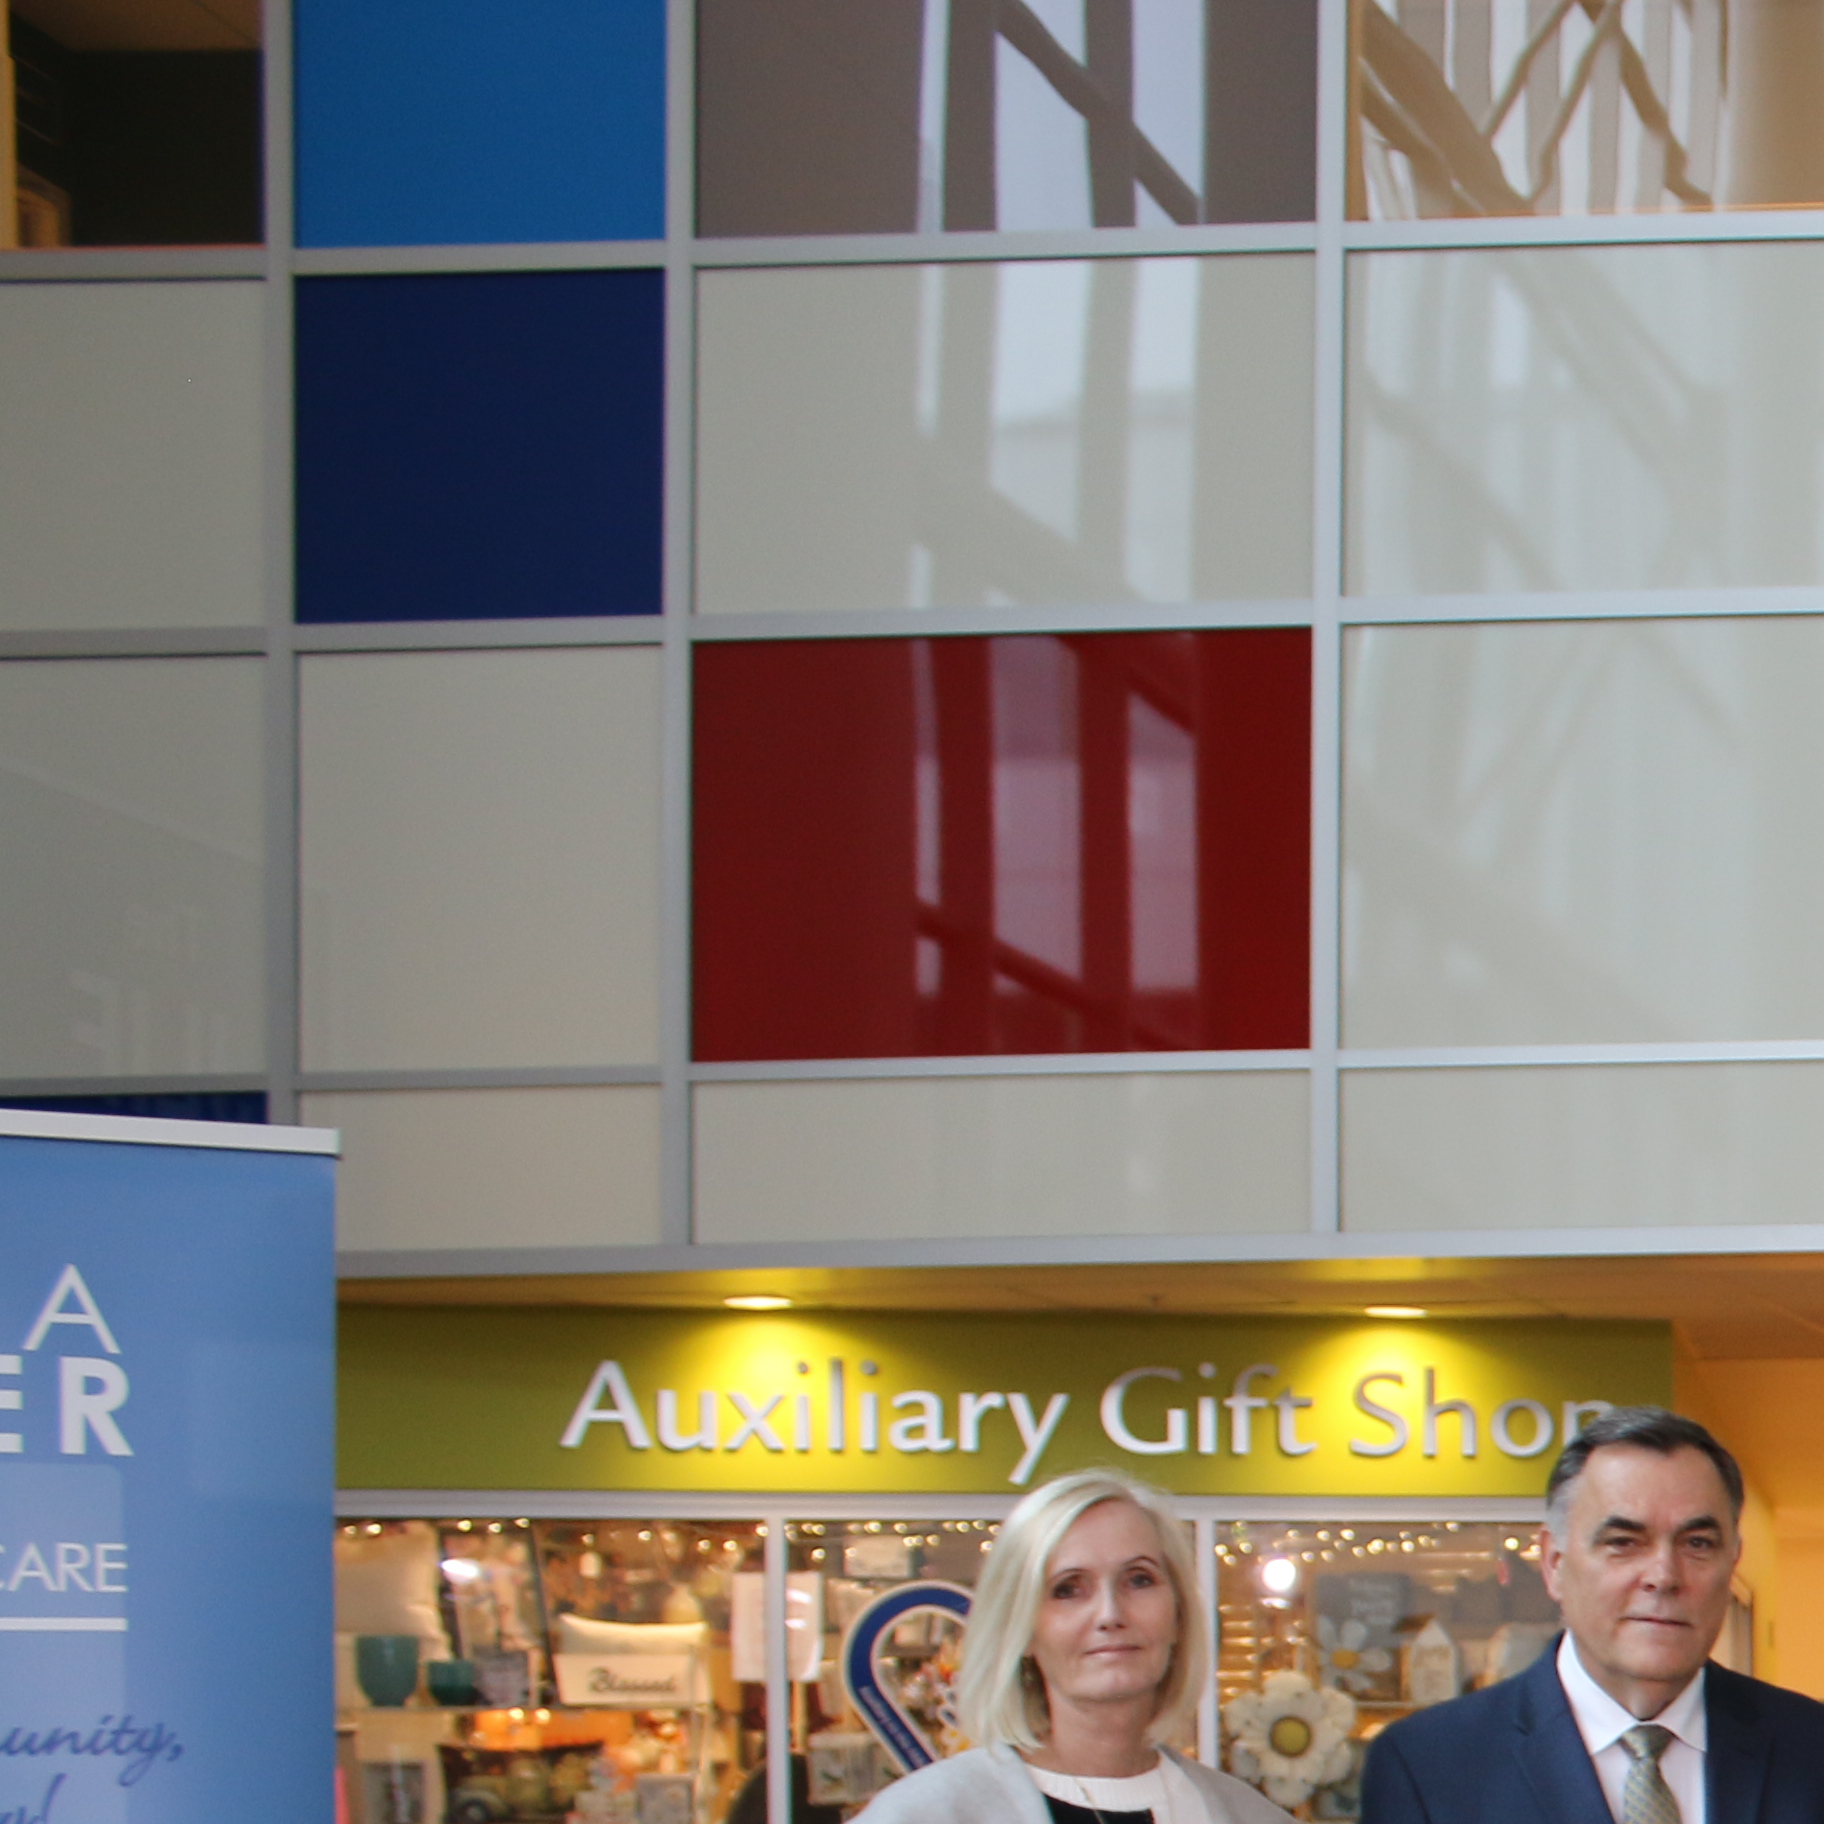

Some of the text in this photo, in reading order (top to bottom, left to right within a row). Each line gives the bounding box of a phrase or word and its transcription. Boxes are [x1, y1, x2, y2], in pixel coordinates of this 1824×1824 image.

[558, 1358, 1070, 1486] Auxiliary
[1099, 1361, 1318, 1457] Gift
[0, 1542, 129, 1593] ARE
